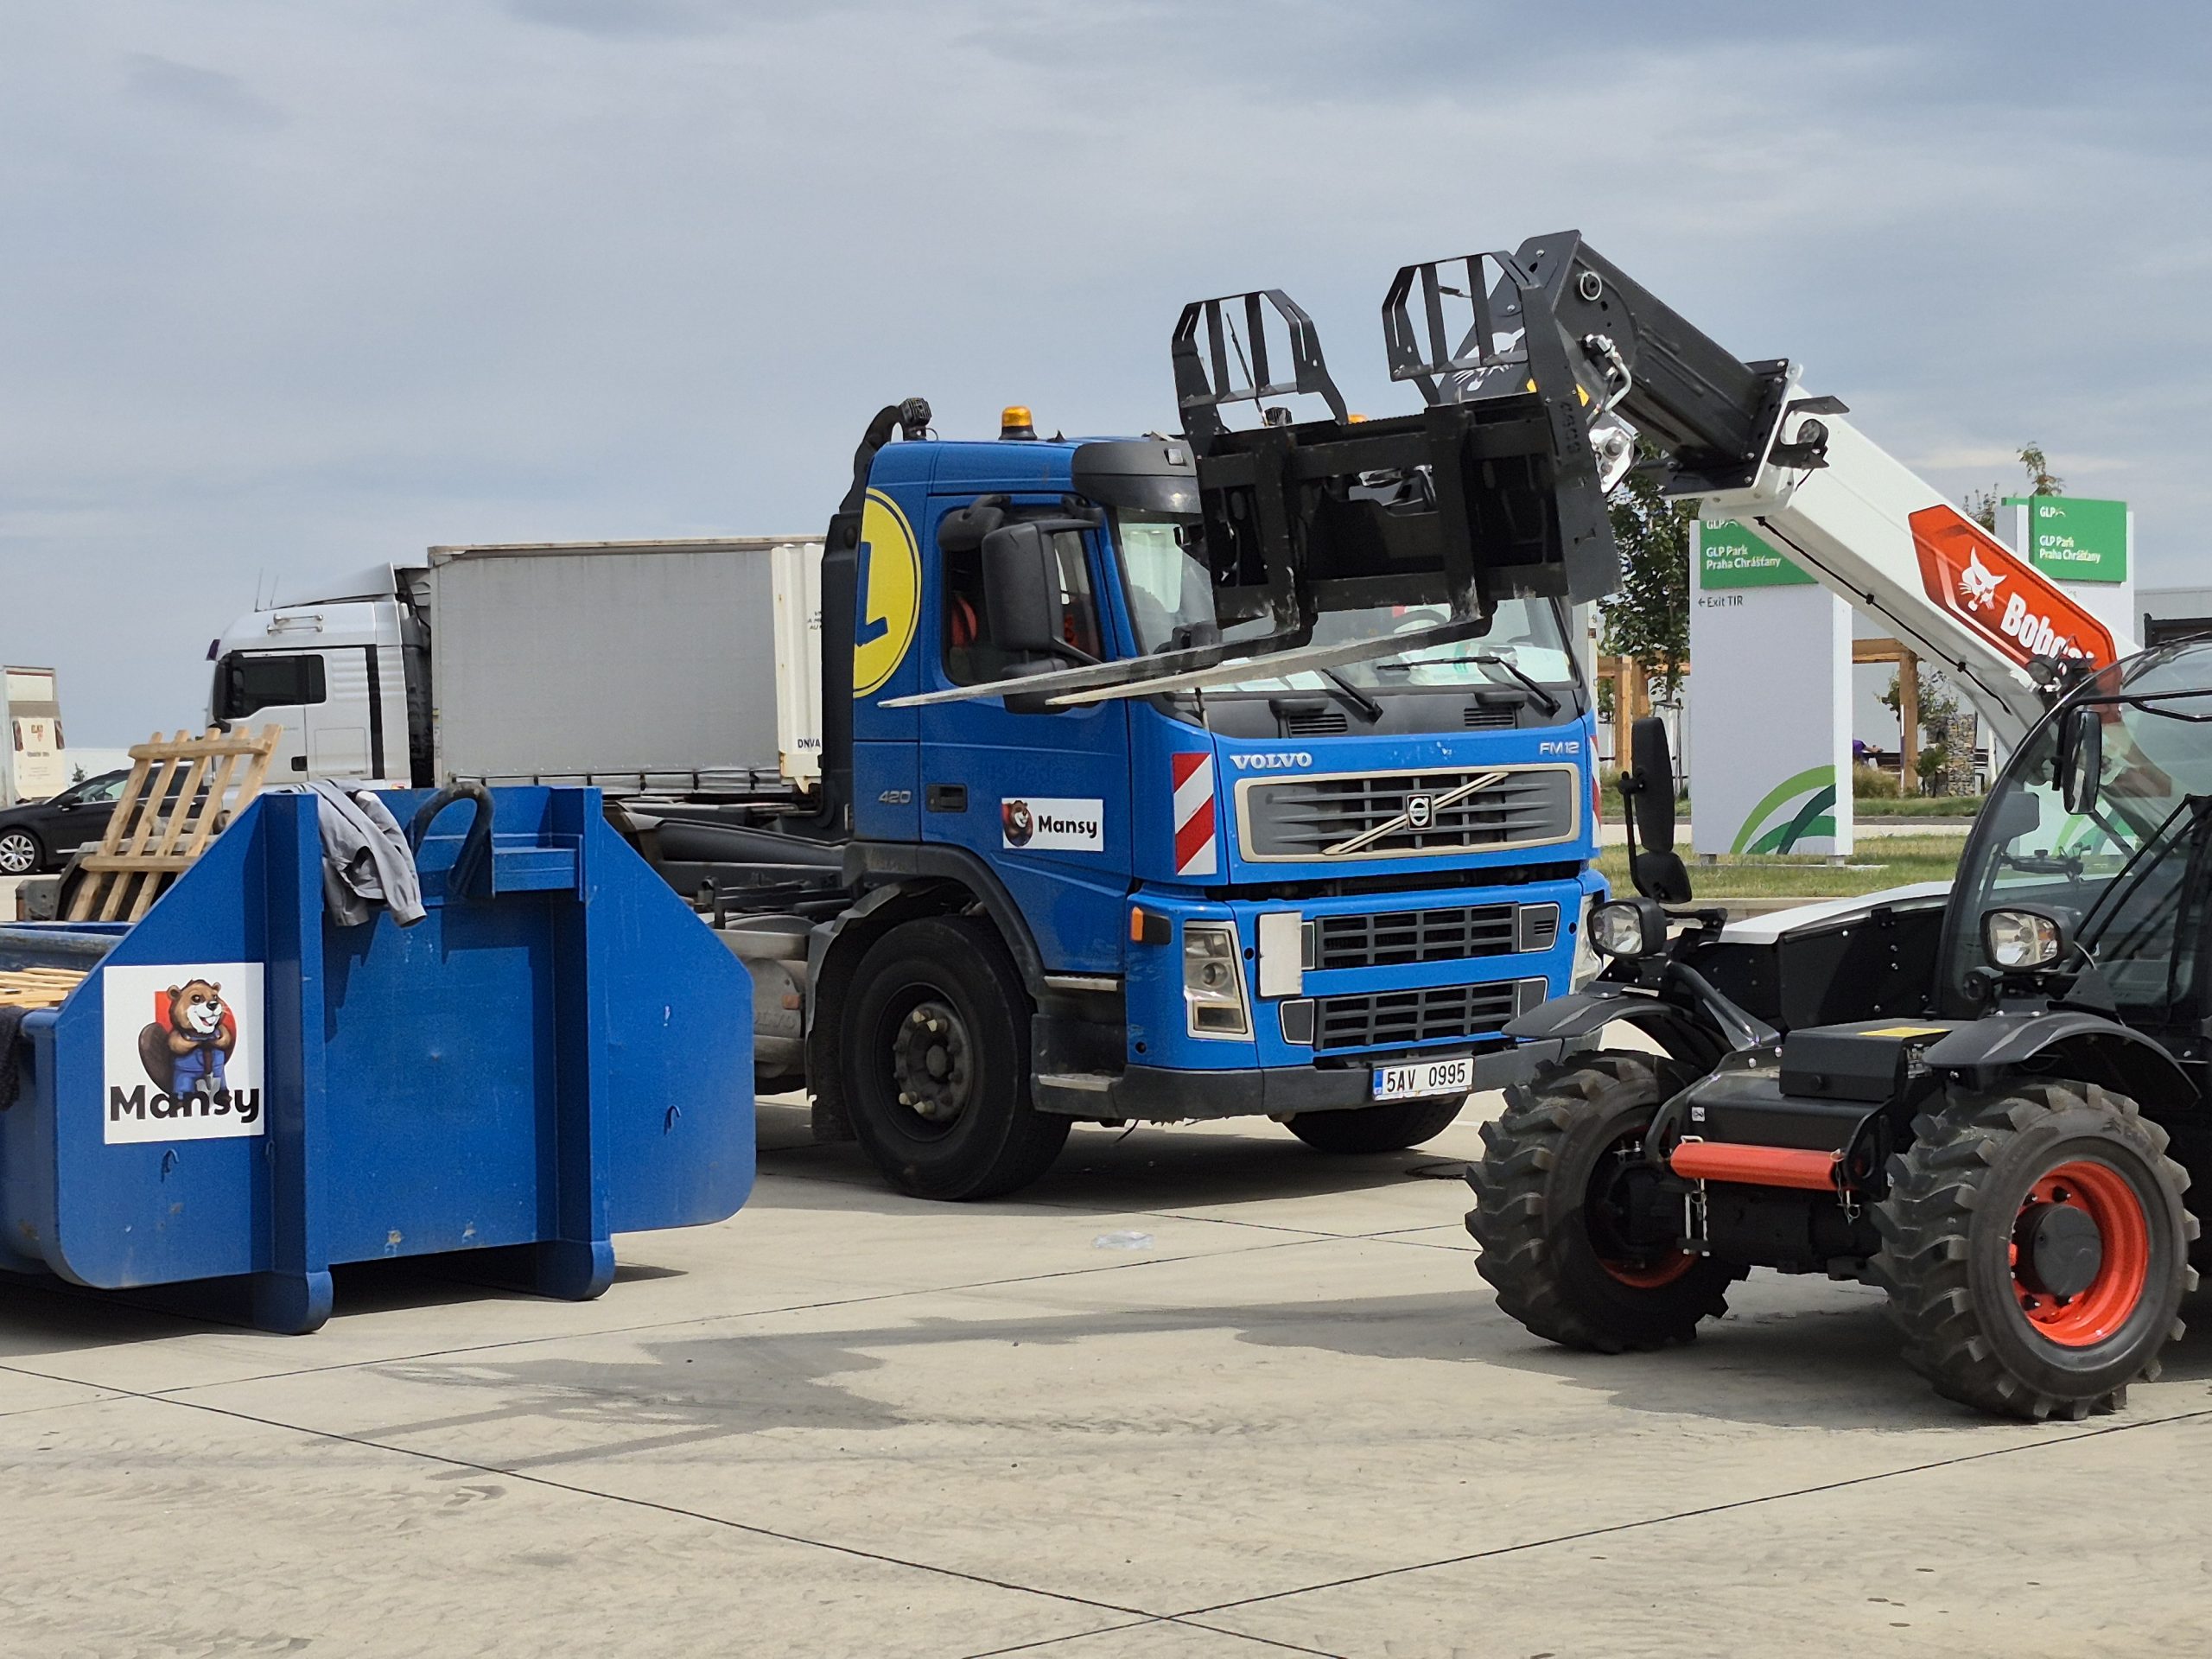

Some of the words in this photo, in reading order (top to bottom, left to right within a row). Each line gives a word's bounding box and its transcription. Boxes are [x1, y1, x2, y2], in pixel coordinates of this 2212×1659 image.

[2039, 506, 2056, 518] GLP
[1706, 519, 1726, 530] GLP
[2039, 535, 2056, 546] GLP
[2056, 537, 2075, 548] Park
[1706, 546, 1725, 557] GLP
[1726, 544, 1748, 556] Park
[2039, 549, 2062, 560] Praha
[1706, 559, 1733, 570] Praha
[1707, 597, 1726, 607] Exit
[1727, 595, 1744, 606] TIR
[1539, 741, 1580, 755] FM12
[1229, 752, 1313, 770] VOLVO
[878, 790, 912, 804] 420
[1038, 815, 1097, 839] Mansy
[1386, 1069, 1416, 1093] 5AV
[1428, 1062, 1466, 1088] 0995
[110, 1084, 260, 1123] Mansy
